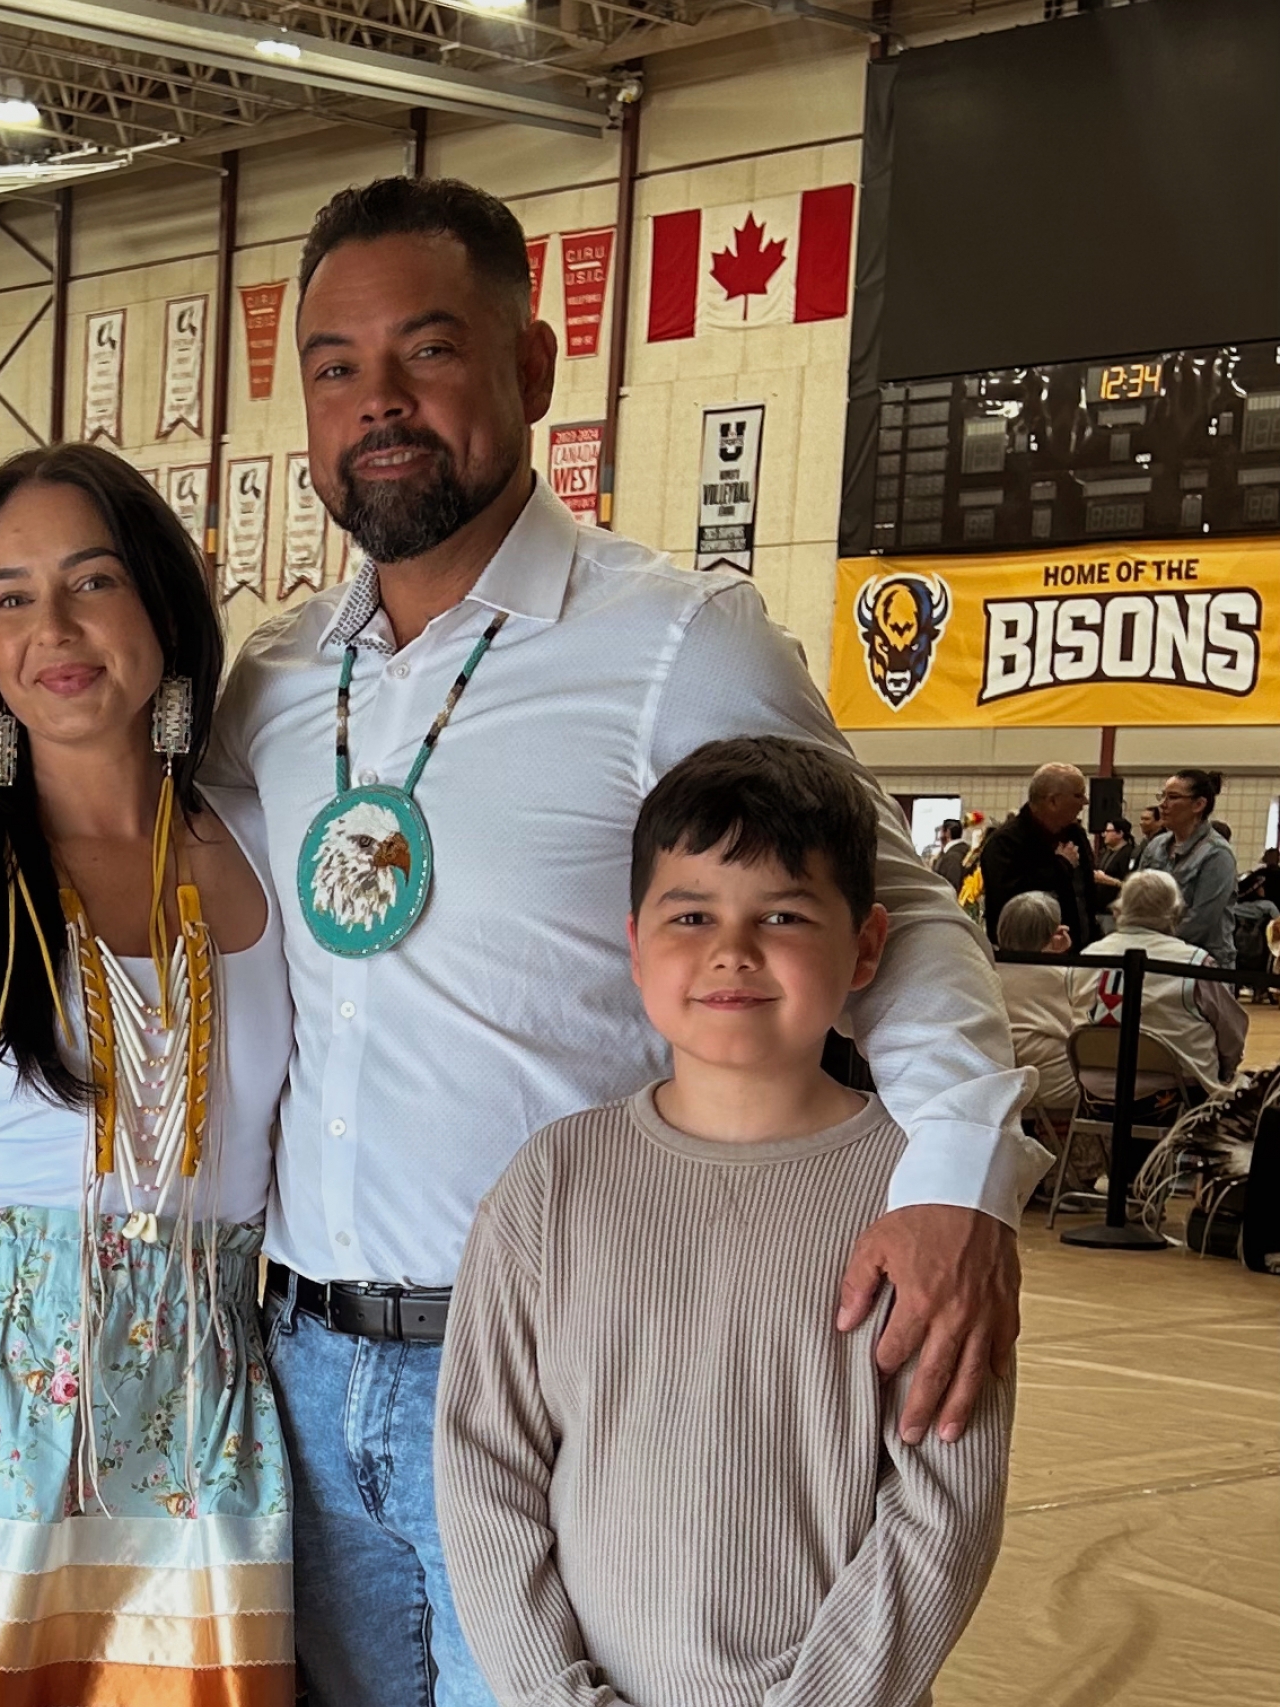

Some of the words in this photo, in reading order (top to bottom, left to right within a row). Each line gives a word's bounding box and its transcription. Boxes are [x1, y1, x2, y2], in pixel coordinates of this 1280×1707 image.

[1100, 363, 1162, 400] 12:34
[553, 465, 597, 494] WEST
[1043, 562, 1111, 587] HOME
[1115, 560, 1147, 583] OF
[1151, 558, 1200, 581] THE
[979, 588, 1260, 703] BISONS
